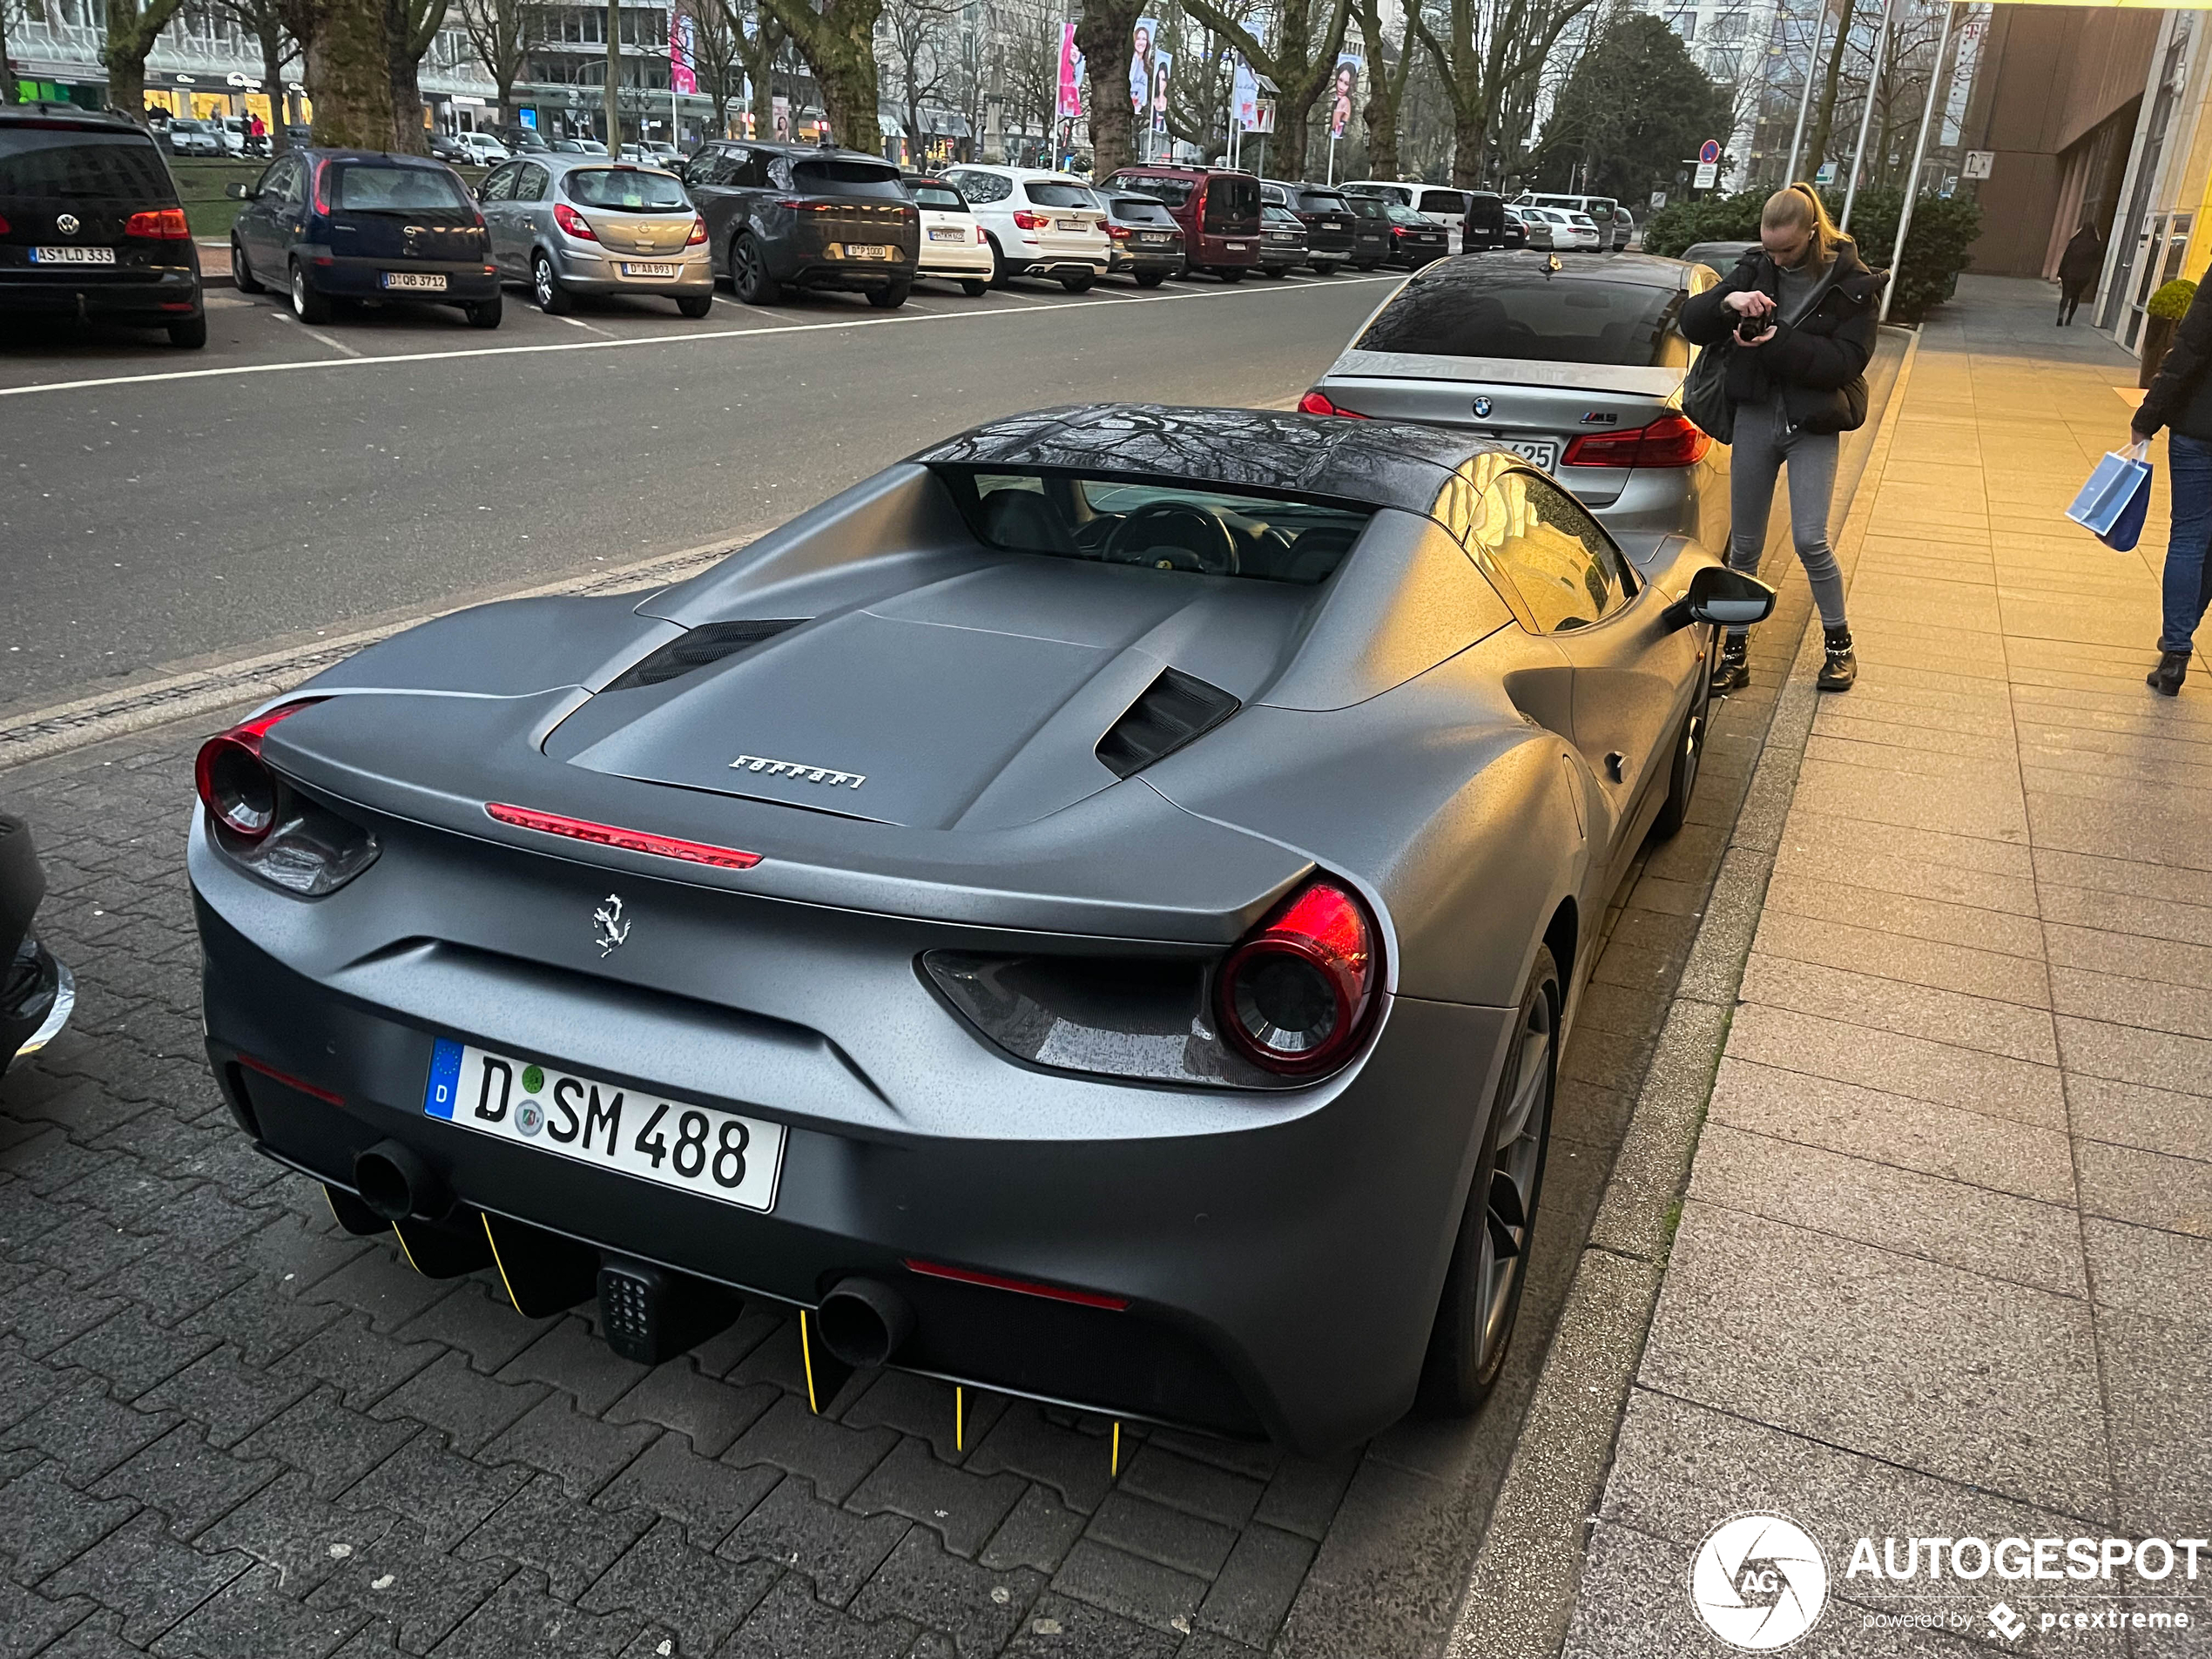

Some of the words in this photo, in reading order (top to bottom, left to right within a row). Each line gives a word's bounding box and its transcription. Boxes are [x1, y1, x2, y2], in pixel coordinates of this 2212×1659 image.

[38, 248, 55, 260] AS
[87, 249, 112, 260] 333
[867, 247, 883, 256] 1000
[631, 264, 637, 273] D
[642, 265, 652, 273] AA
[654, 265, 670, 274] 893
[388, 274, 395, 285] D
[419, 276, 445, 287] 3712
[728, 754, 867, 789] Ferrari
[435, 1085, 448, 1103] D
[475, 1056, 512, 1123] D
[547, 1078, 624, 1157] SM
[635, 1103, 750, 1189] 488
